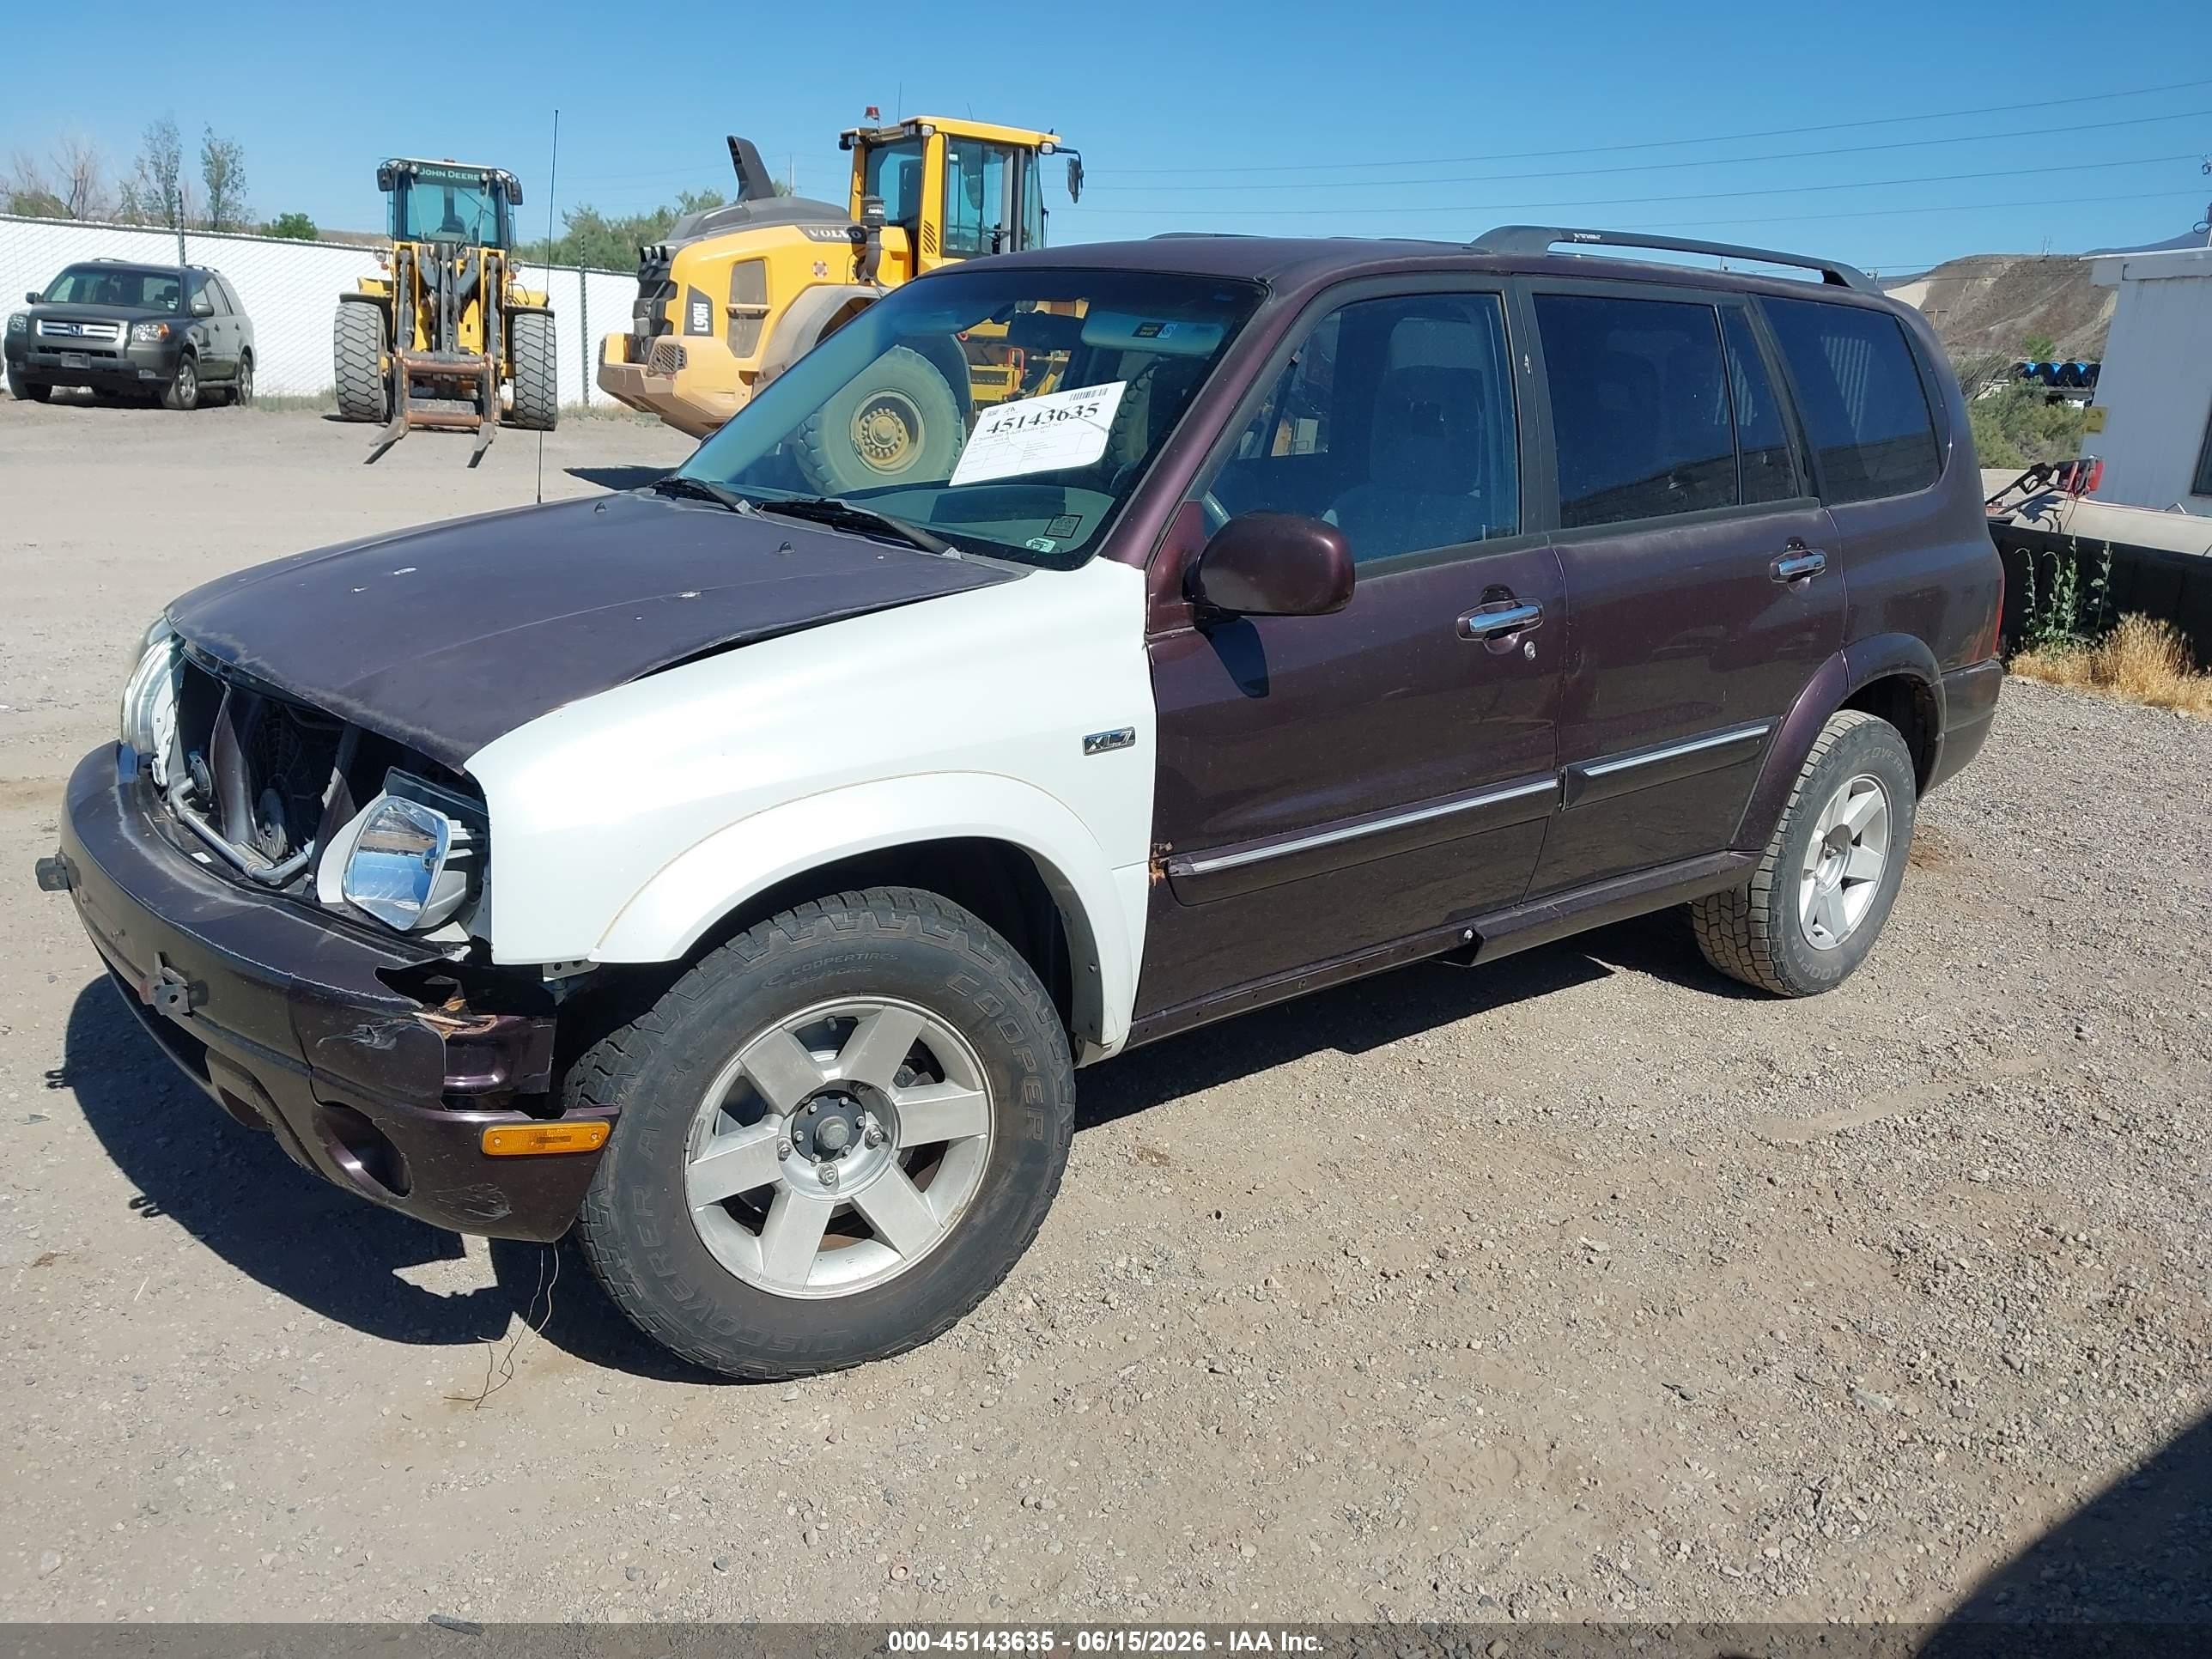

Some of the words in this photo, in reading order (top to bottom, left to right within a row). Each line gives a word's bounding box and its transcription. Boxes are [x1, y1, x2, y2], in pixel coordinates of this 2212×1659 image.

[419, 167, 446, 177] JOHN
[447, 170, 480, 181] DEERE
[809, 228, 862, 239] VOLVO
[693, 301, 708, 331] L90H
[987, 403, 1100, 434] 45143635
[946, 969, 1045, 1141] COOPER
